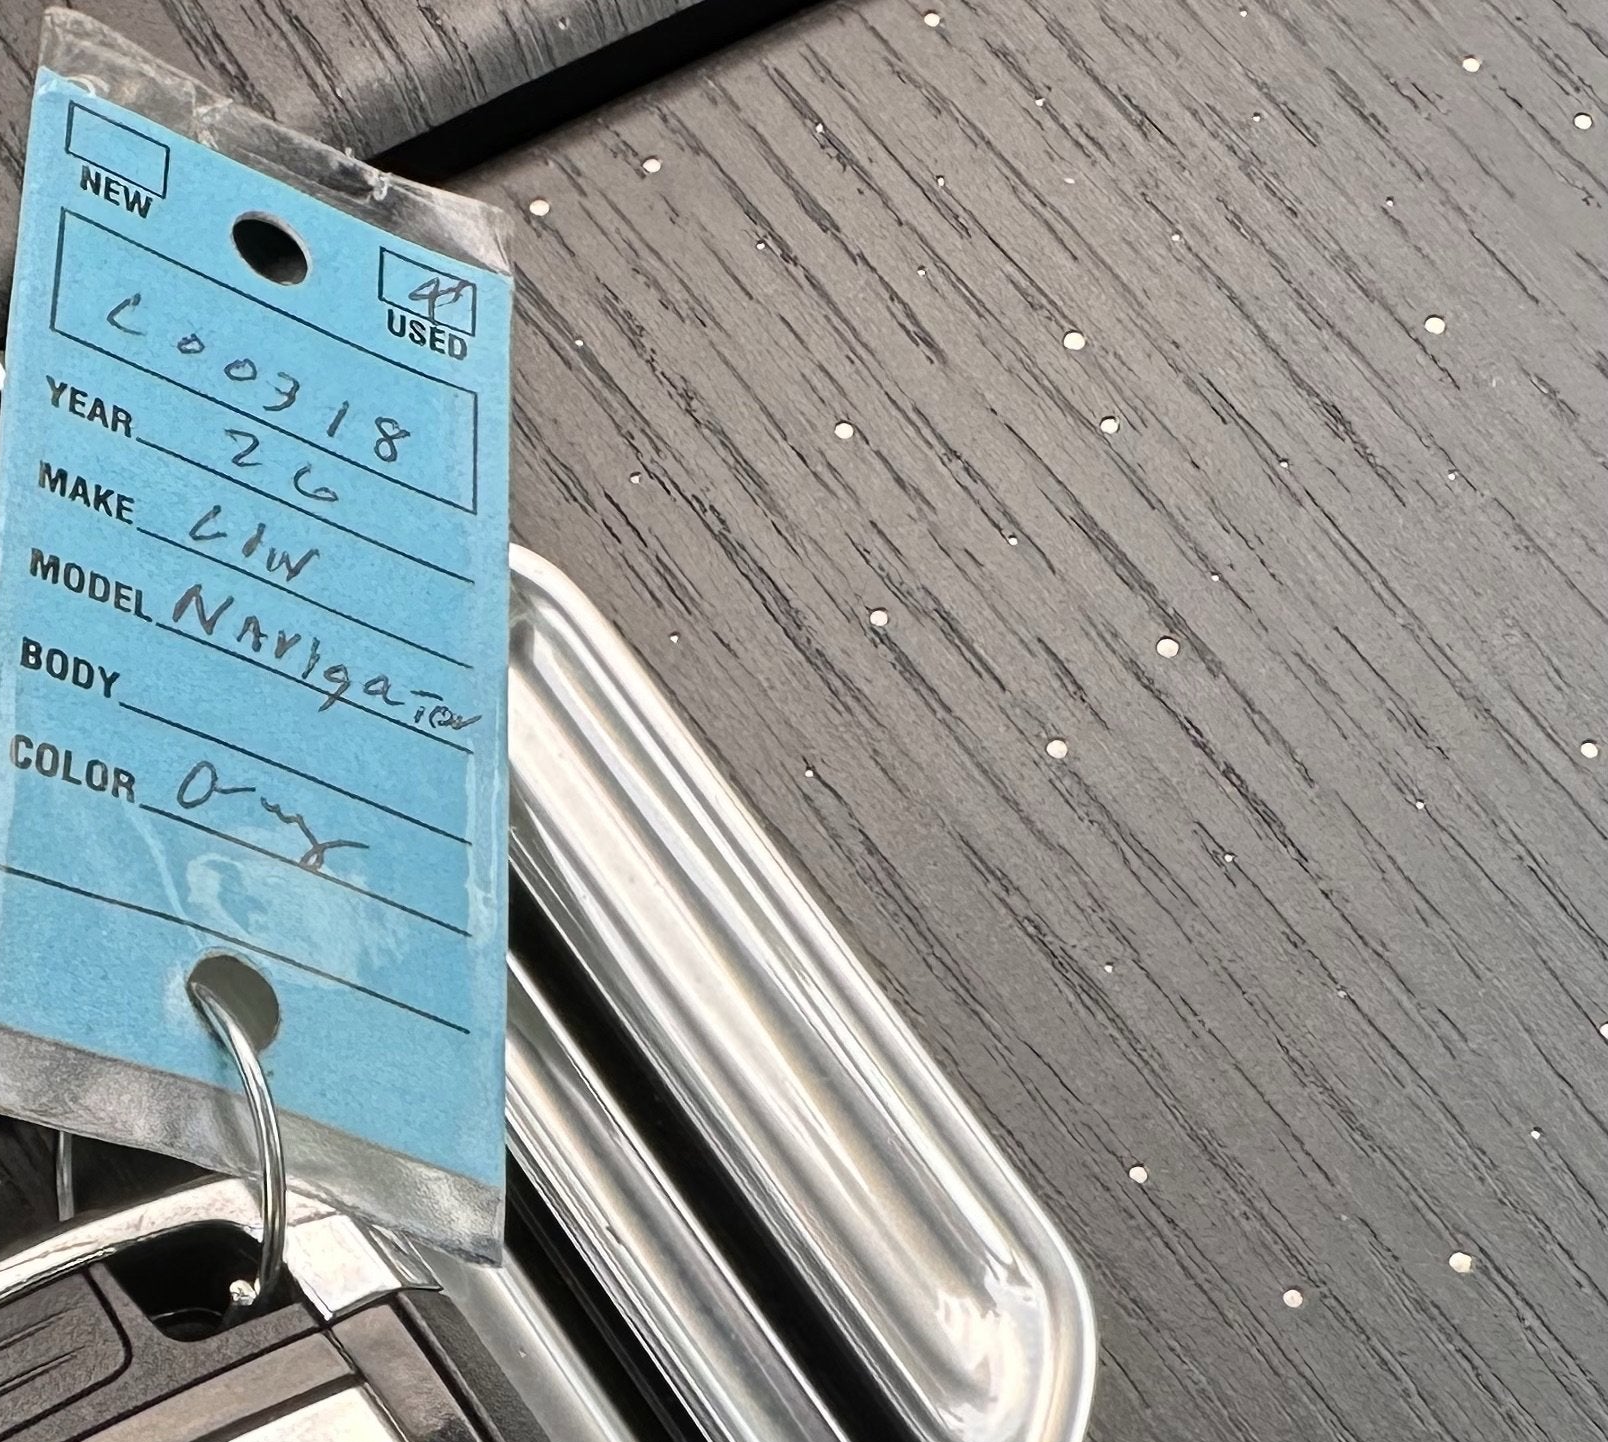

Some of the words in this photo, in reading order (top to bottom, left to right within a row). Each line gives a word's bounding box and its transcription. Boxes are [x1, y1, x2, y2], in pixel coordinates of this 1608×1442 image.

[80, 165, 153, 219] NEW
[387, 308, 468, 361] USED
[45, 375, 134, 438] YEAR
[38, 460, 135, 525] MAKE
[29, 547, 153, 623] MODEL
[20, 636, 121, 698] BODY
[9, 734, 135, 804] COLOR
